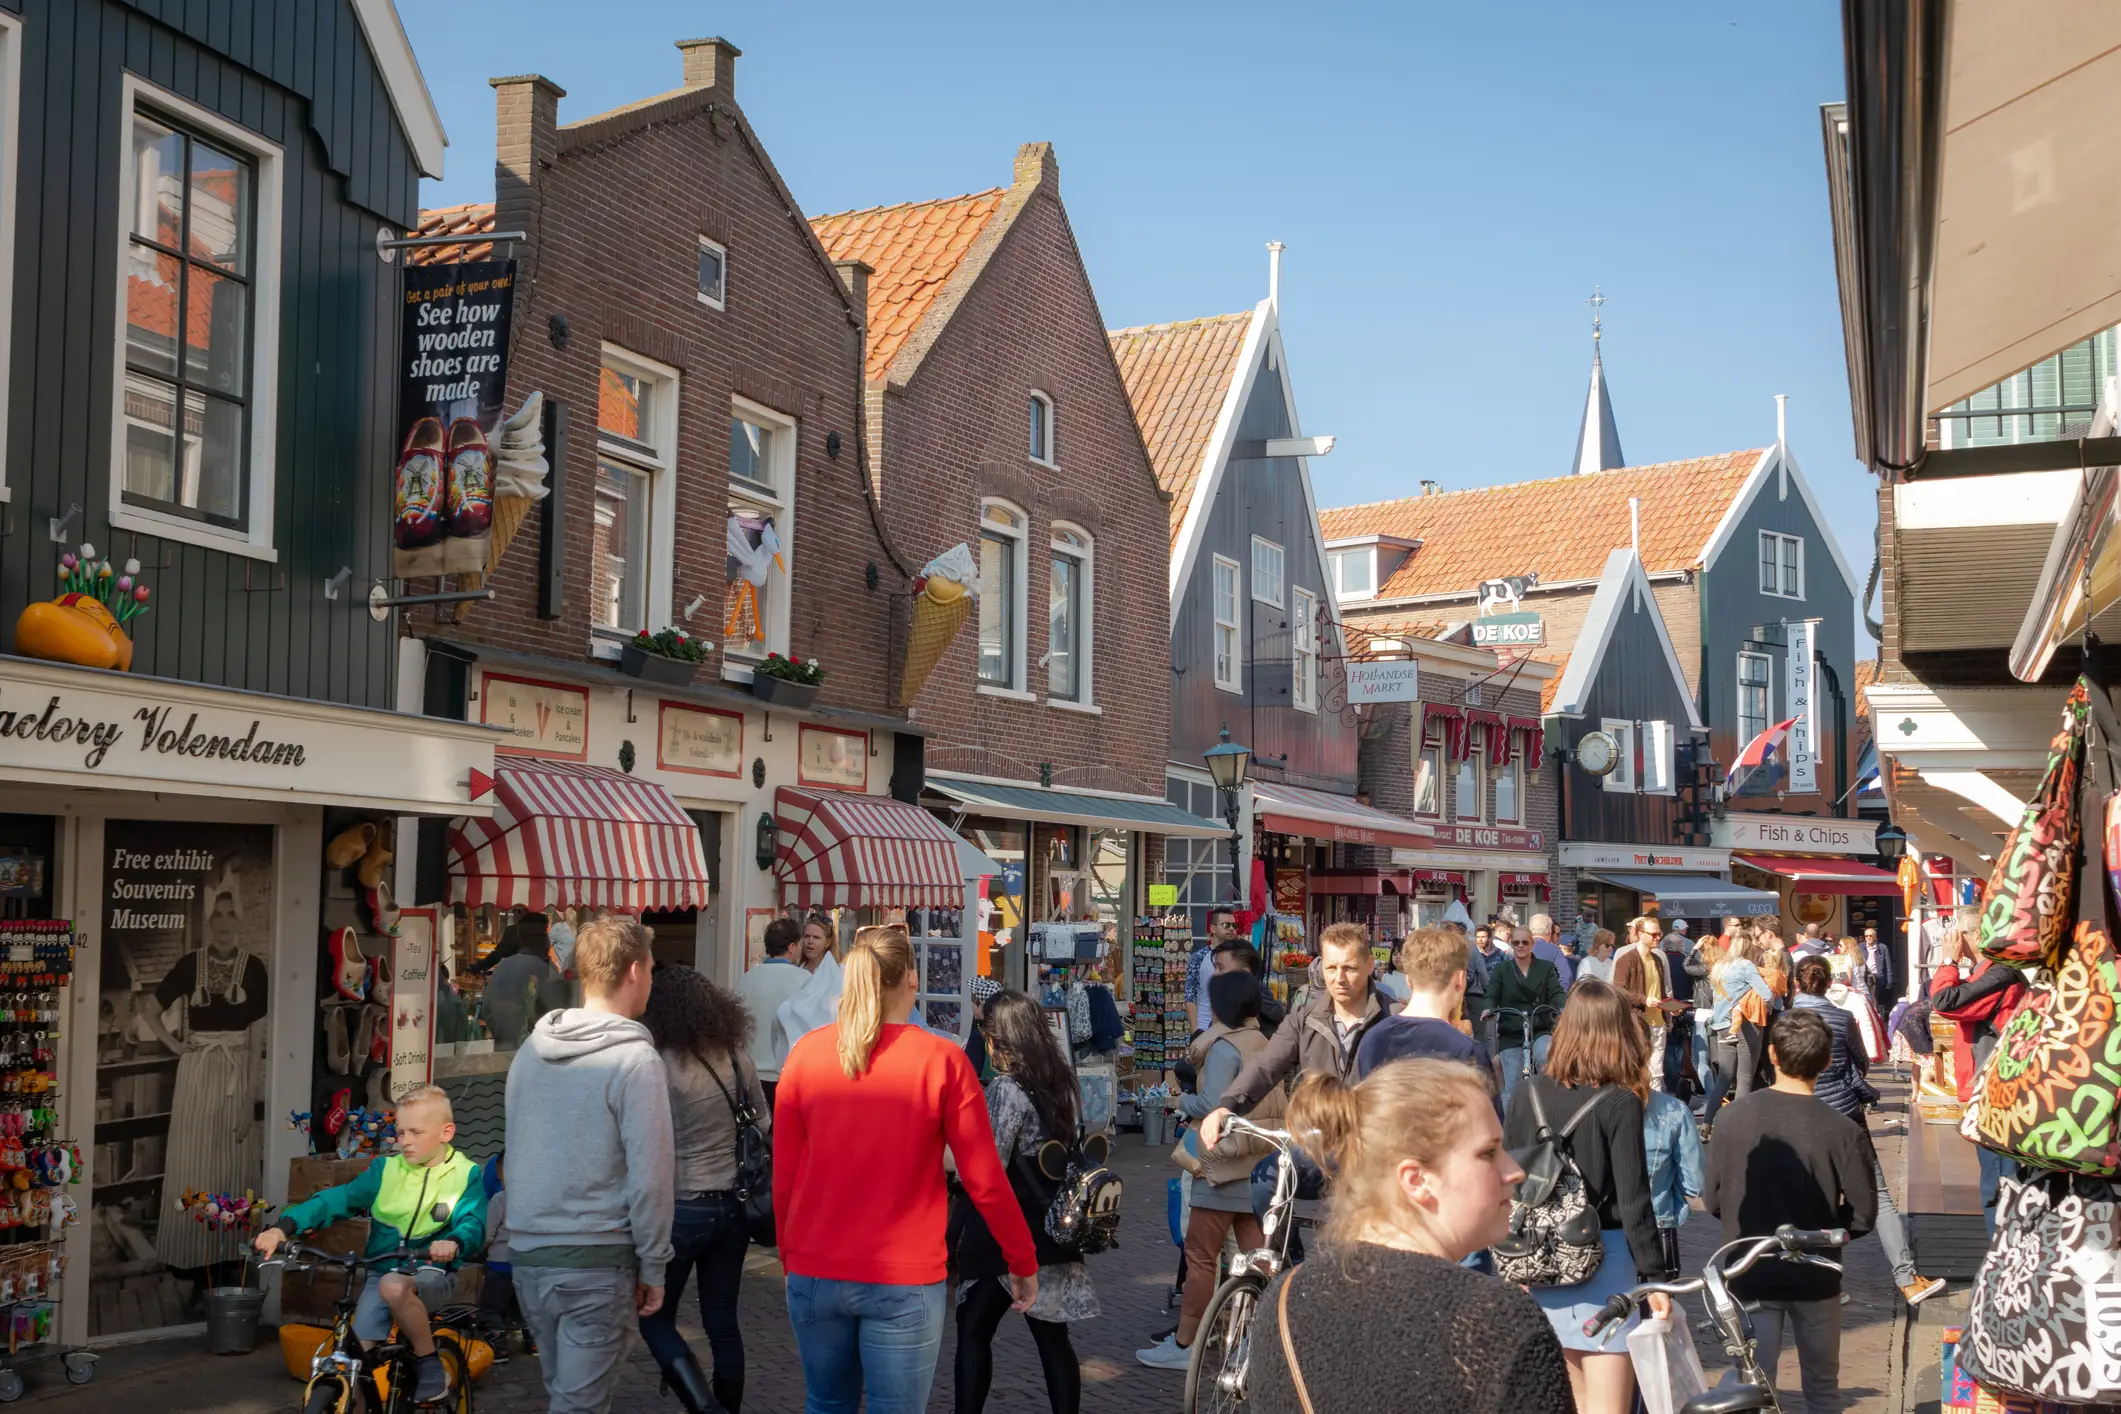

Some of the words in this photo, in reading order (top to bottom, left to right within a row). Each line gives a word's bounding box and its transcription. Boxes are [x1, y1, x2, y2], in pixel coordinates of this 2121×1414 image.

[424, 291, 430, 300] a
[432, 284, 454, 302] pair
[456, 281, 466, 296] of
[468, 280, 489, 296] your
[417, 302, 453, 327] See
[455, 298, 501, 324] how
[418, 323, 496, 352] wooden
[410, 352, 463, 378] shoes
[466, 354, 500, 373] are
[425, 374, 480, 402] made
[1474, 624, 1498, 642] DE
[1503, 623, 1540, 641] KOE
[1795, 638, 1806, 688] Fish
[1351, 668, 1415, 683] HOLLANDSE
[1362, 682, 1403, 695] MARKT
[555, 703, 564, 714] Ice
[565, 706, 583, 716] cream
[1795, 697, 1808, 706] &
[0, 696, 123, 769] actory
[133, 706, 306, 767] Volendam
[555, 731, 581, 744] Pancakes
[1456, 828, 1471, 843] DE
[1475, 829, 1498, 845] KOE
[1759, 825, 1789, 841] Fish
[1794, 829, 1804, 842] &
[1809, 827, 1849, 845] Chips
[112, 849, 151, 870] Free
[154, 849, 215, 871] exhibit
[112, 878, 196, 899] Souvenirs
[1748, 903, 1774, 914] GUCCI
[110, 908, 186, 930] Museum
[409, 1050, 427, 1064] Drinks
